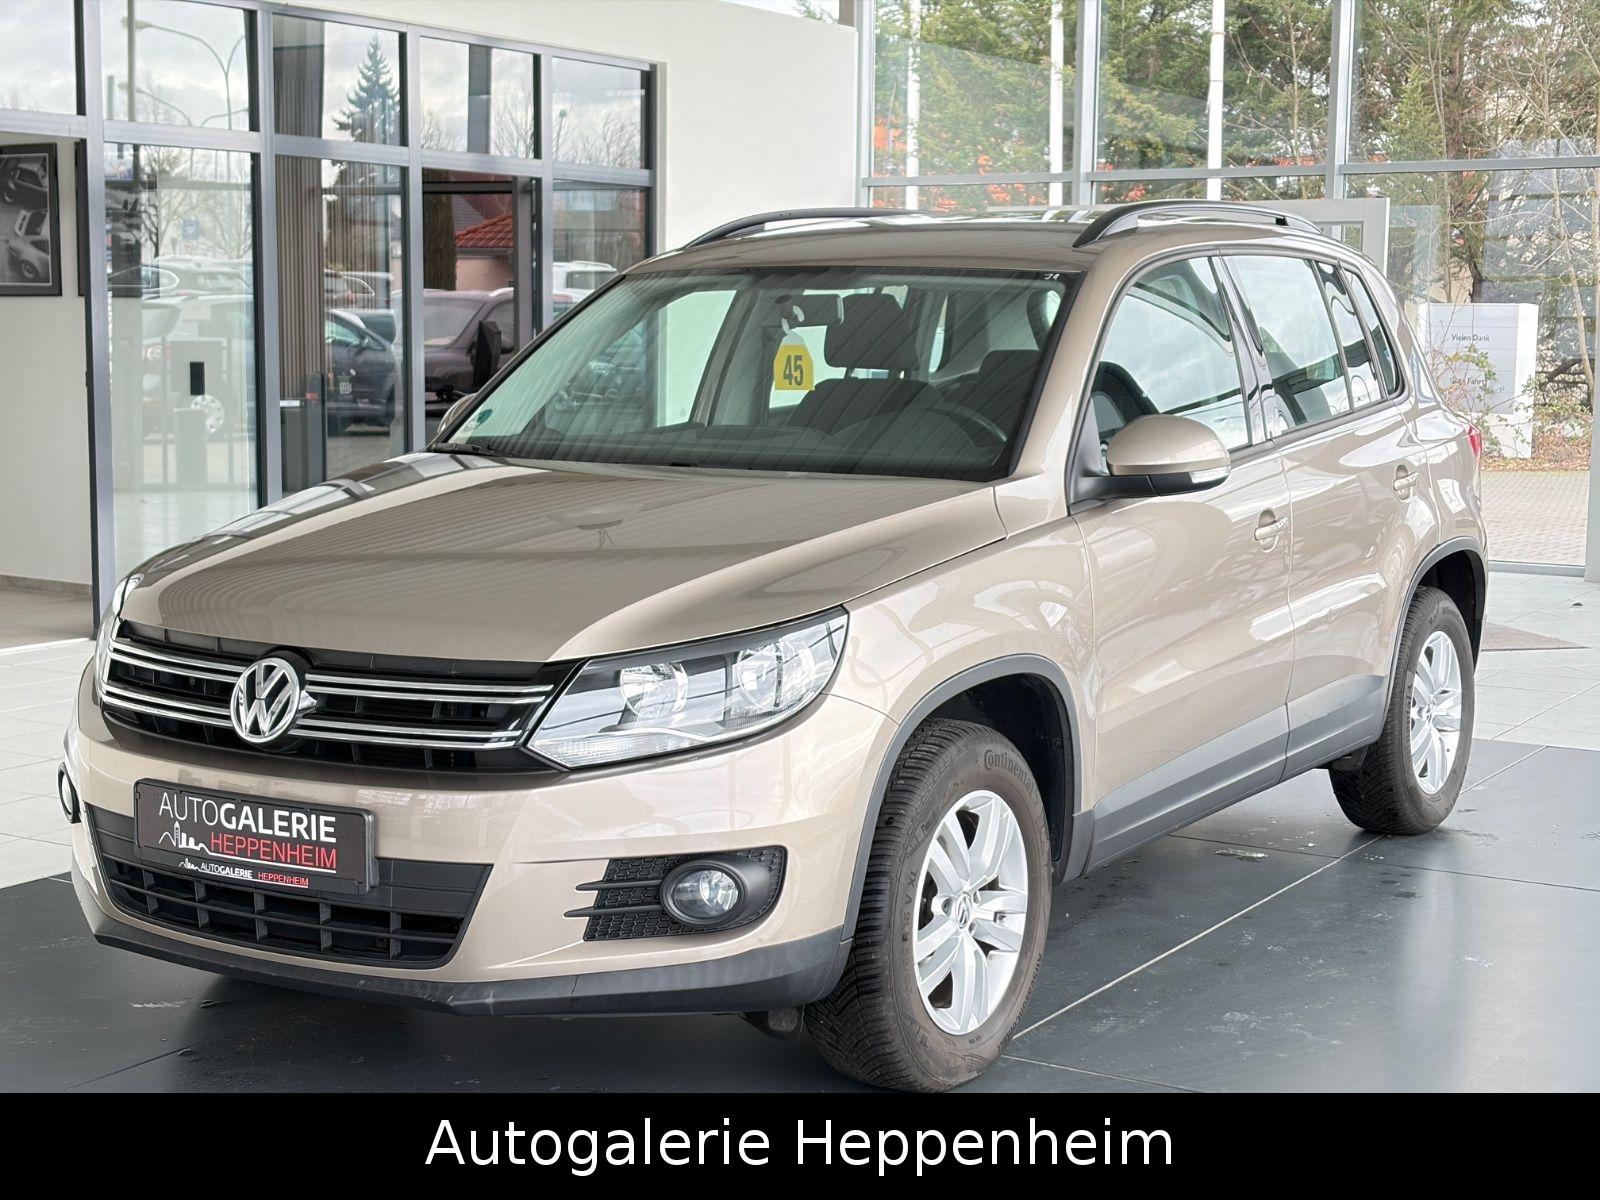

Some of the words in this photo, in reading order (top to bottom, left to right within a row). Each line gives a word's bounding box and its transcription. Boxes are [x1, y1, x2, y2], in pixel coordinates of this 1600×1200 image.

[1472, 333, 1490, 342] Dank
[783, 354, 804, 386] 45
[983, 749, 1036, 797] Continental
[158, 791, 337, 843] AUTOGALERIE
[209, 831, 337, 869] HEPPENHEIM
[200, 862, 253, 879] AUTOGALERIE
[257, 871, 309, 886] HEPPENHEIM
